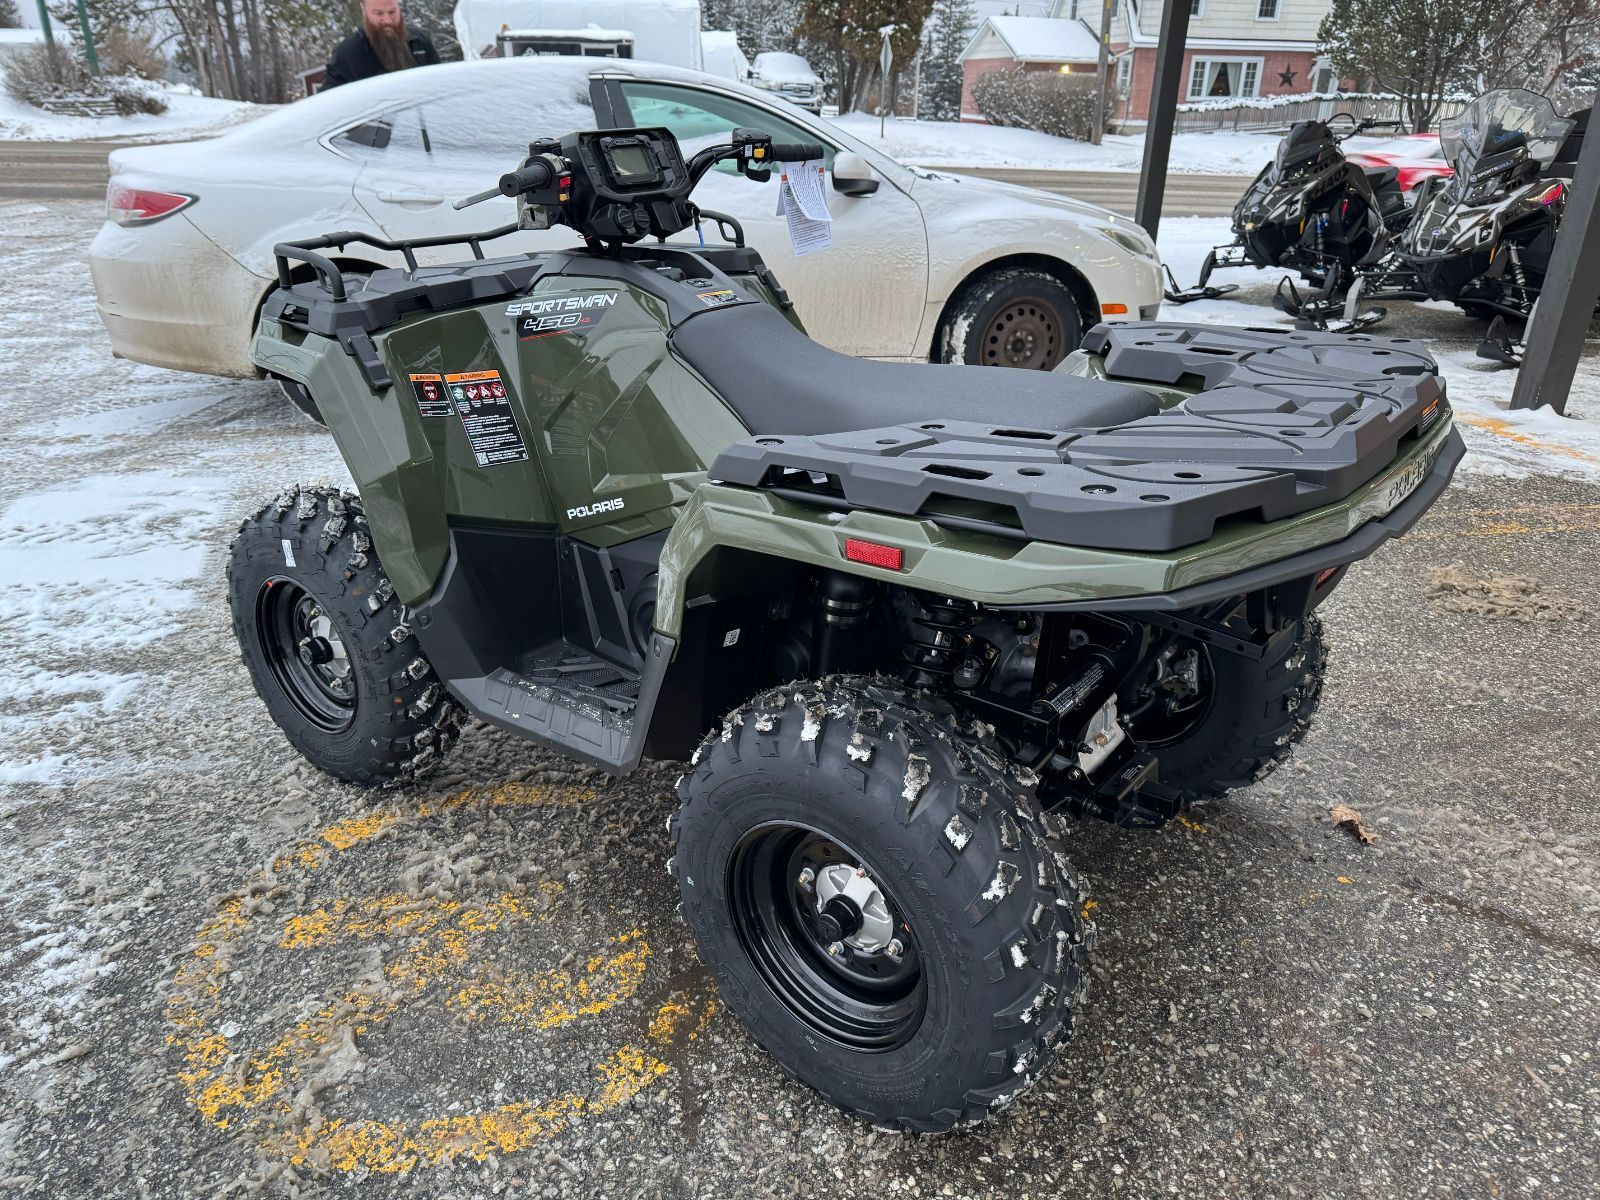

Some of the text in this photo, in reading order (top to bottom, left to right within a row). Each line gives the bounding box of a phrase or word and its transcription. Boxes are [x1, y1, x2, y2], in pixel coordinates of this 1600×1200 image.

[505, 293, 618, 316] SPORTSMAN
[524, 312, 582, 331] 450
[566, 497, 625, 520] POLARIS
